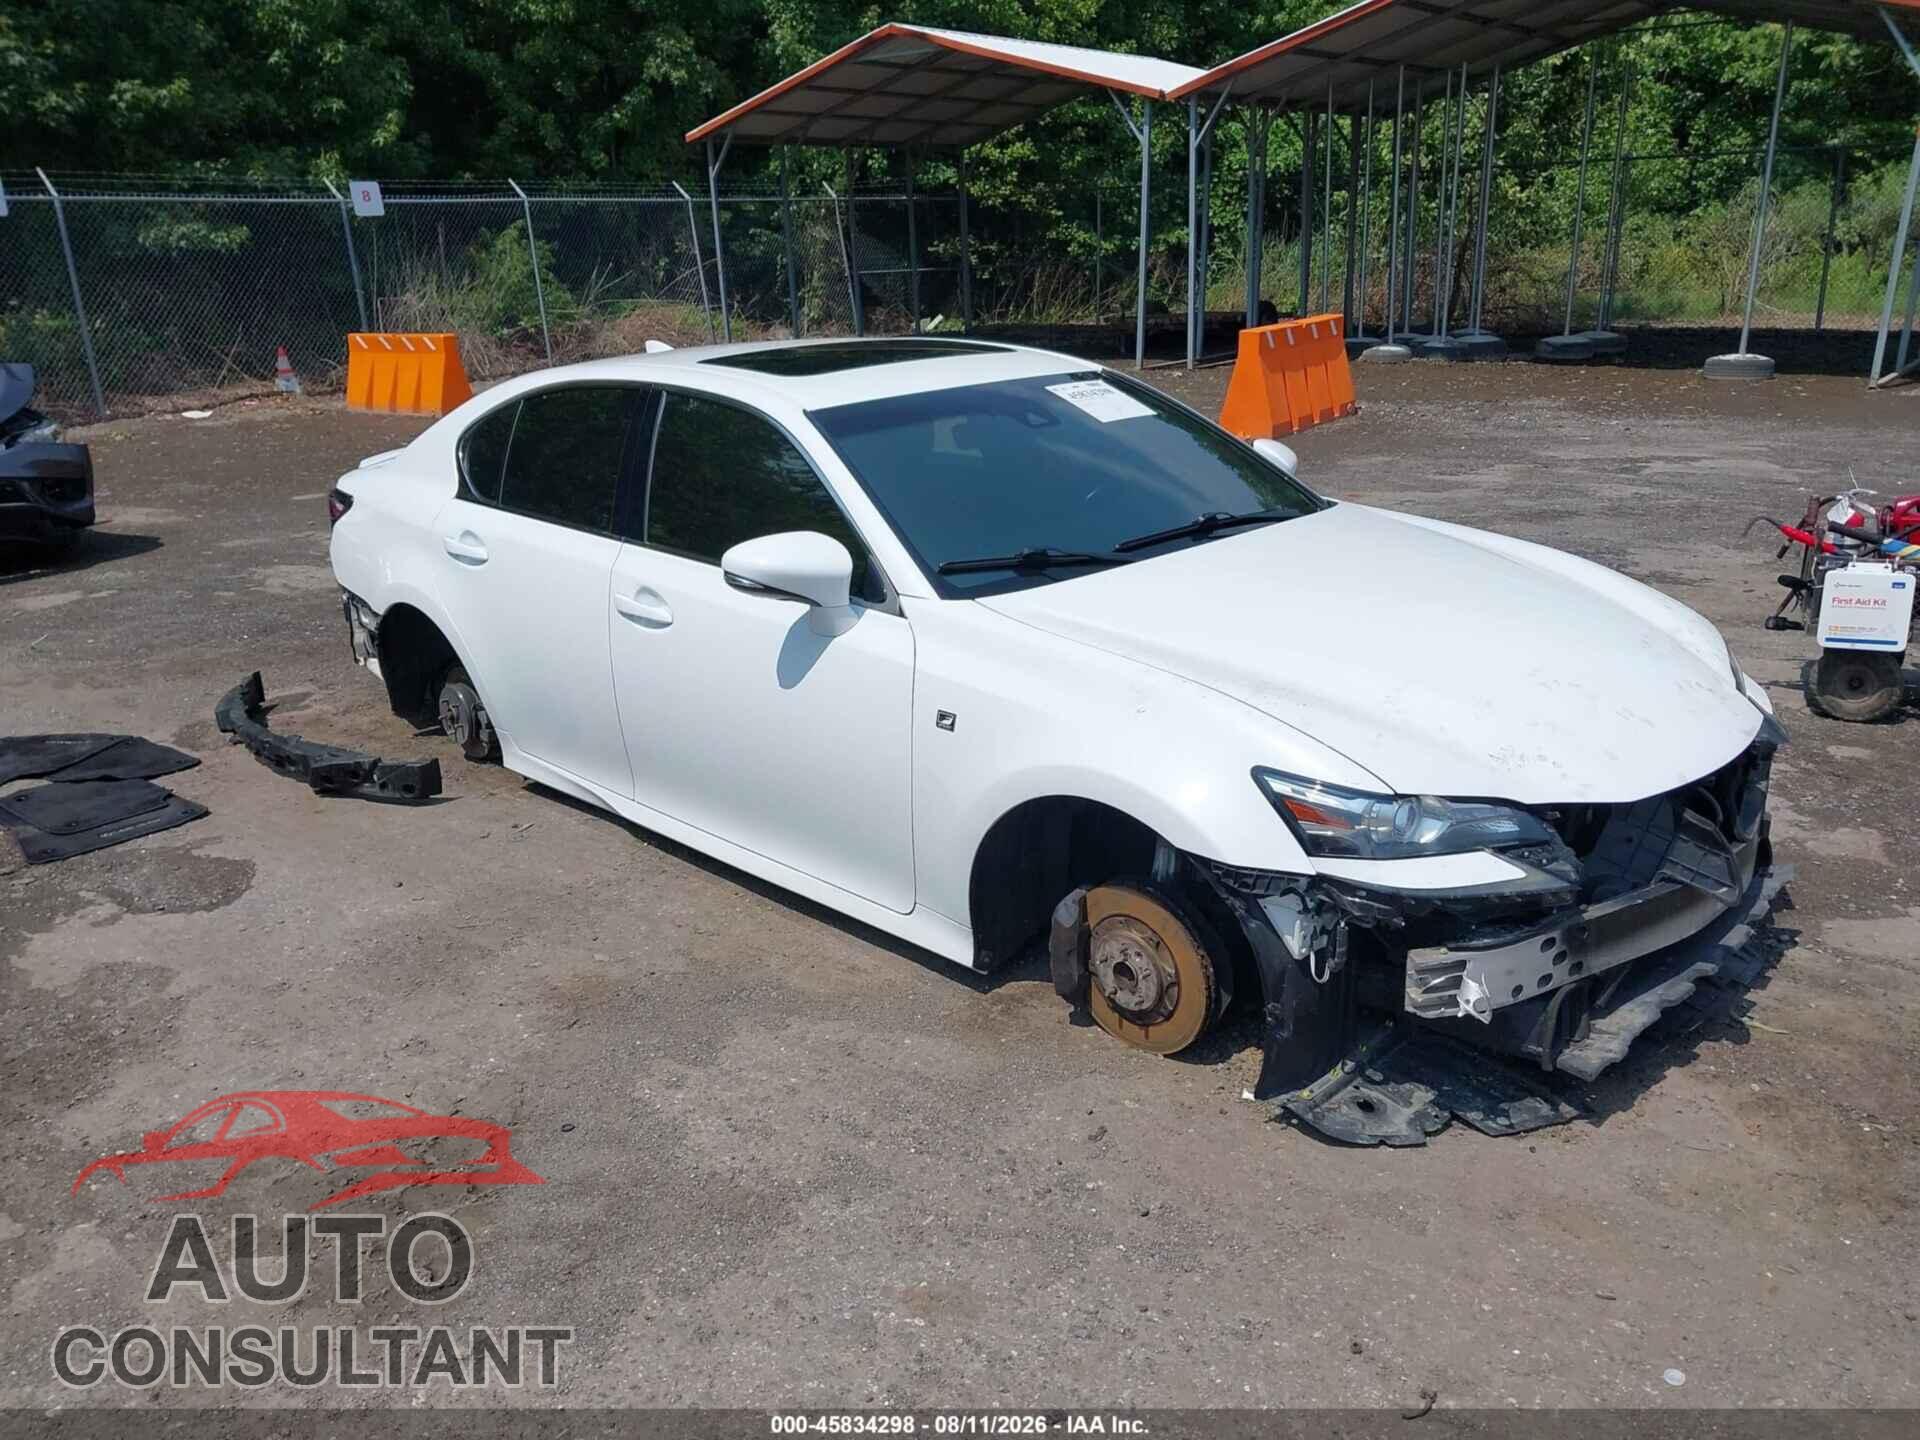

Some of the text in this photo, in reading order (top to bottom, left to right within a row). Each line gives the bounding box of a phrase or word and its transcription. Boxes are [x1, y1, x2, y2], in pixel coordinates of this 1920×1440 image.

[1831, 596, 1887, 607] First Aid Kit
